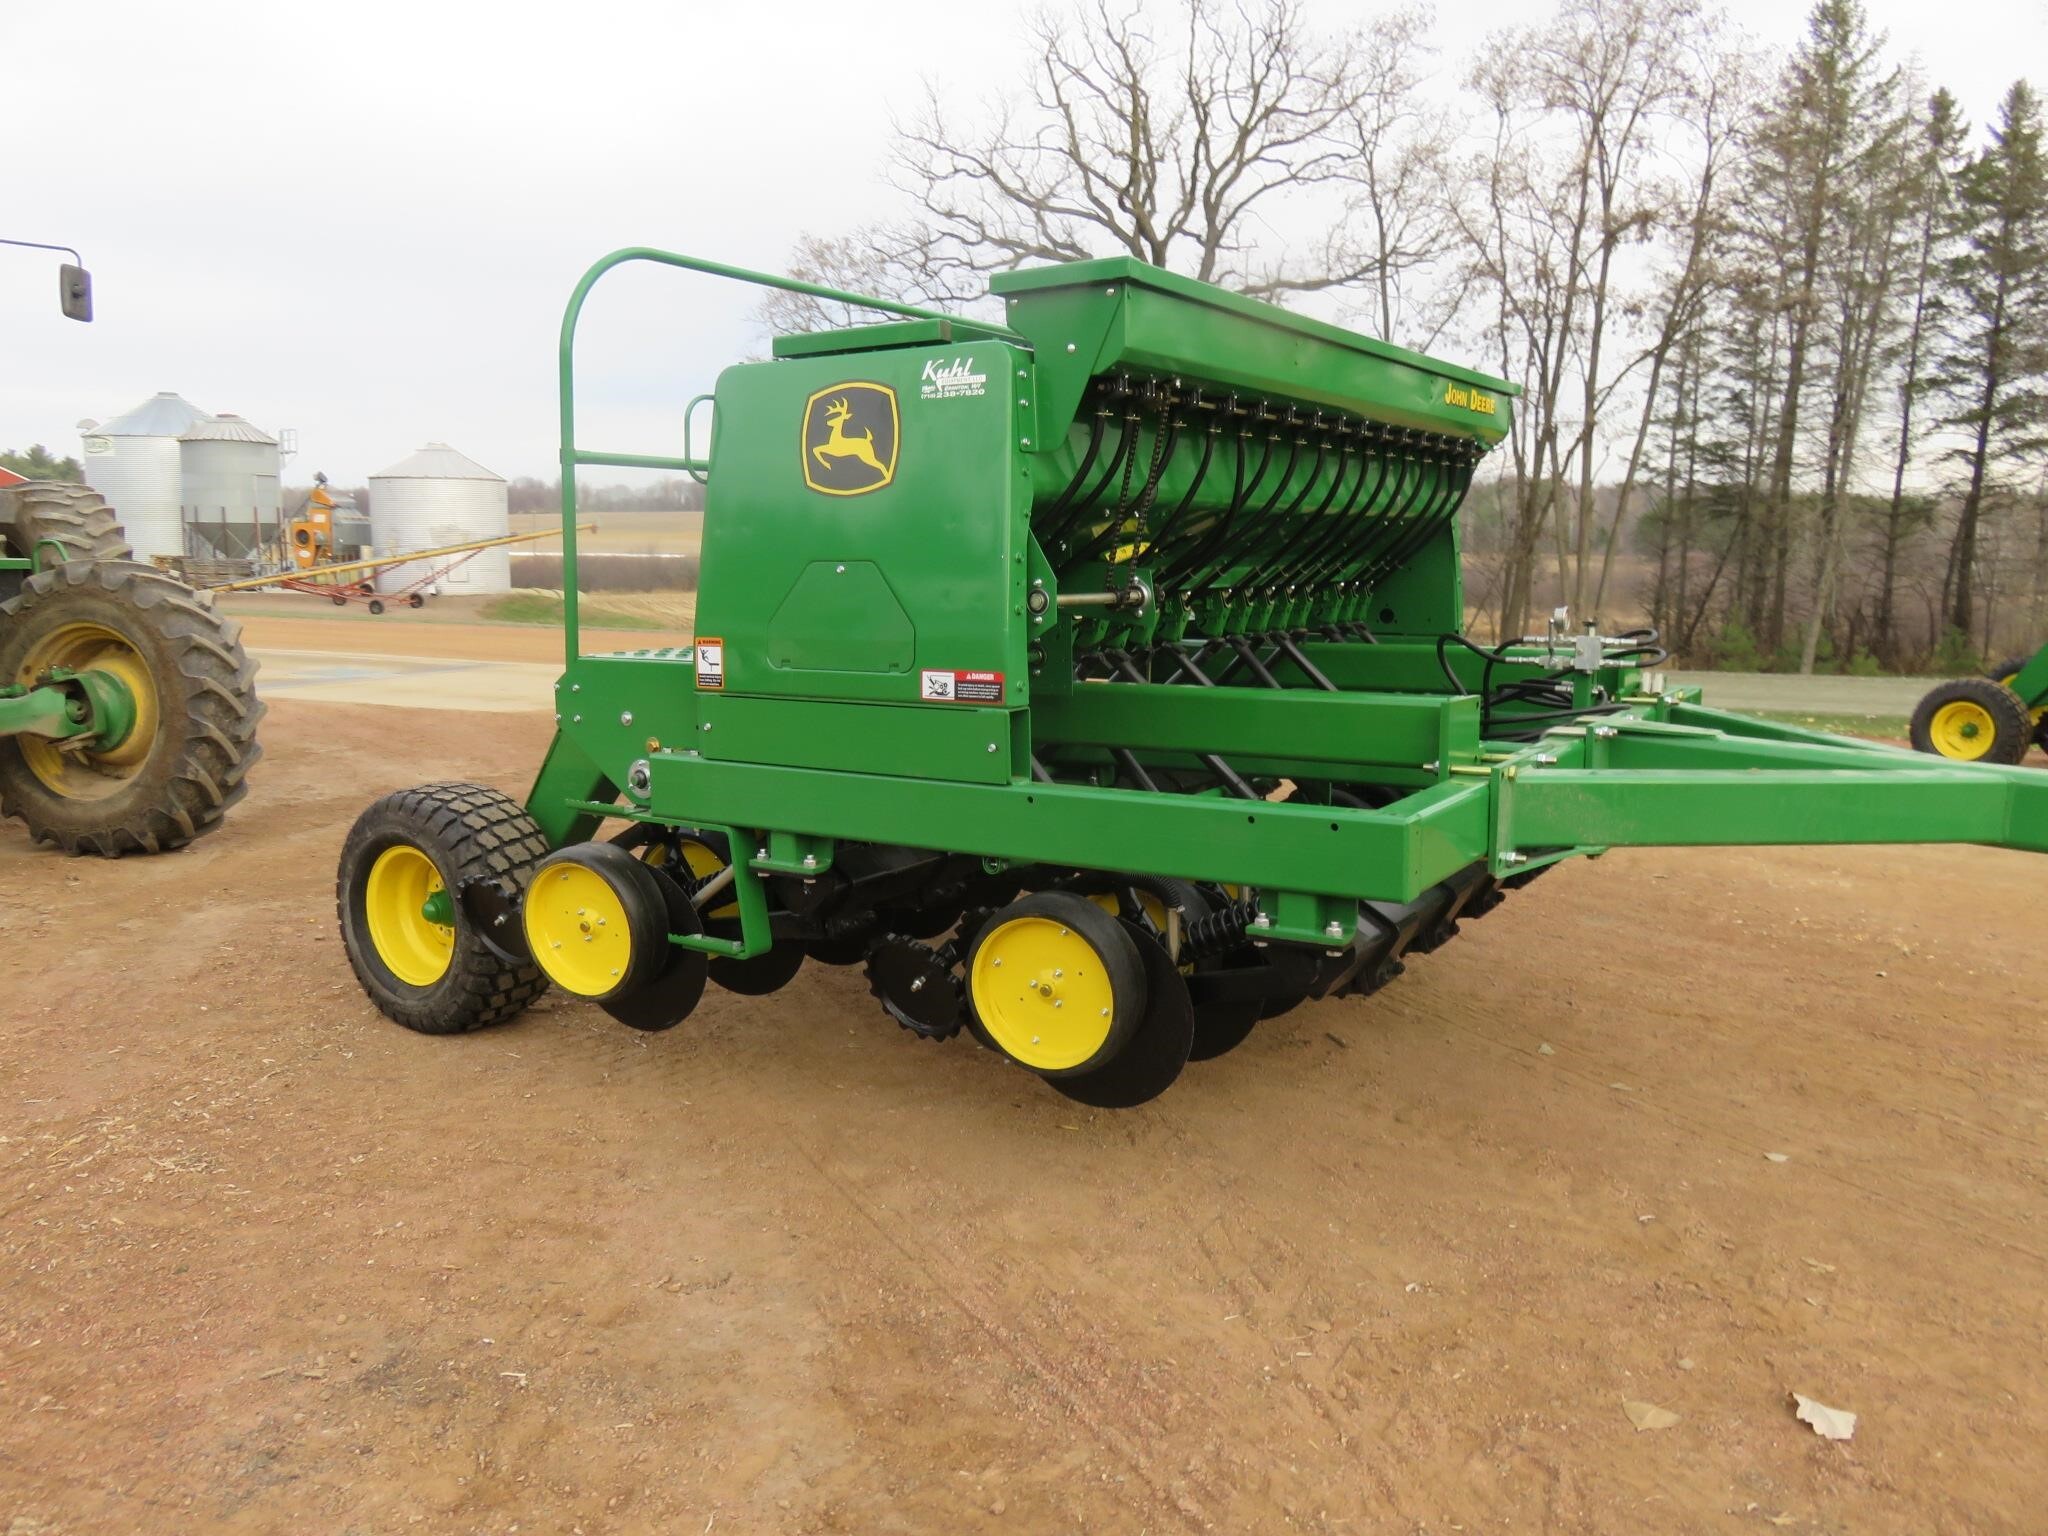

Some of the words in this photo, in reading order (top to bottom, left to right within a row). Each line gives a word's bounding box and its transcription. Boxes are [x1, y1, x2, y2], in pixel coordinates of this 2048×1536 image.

[921, 358, 971, 380] Kuhl
[1445, 383, 1467, 406] JOHN
[1471, 389, 1495, 414] DEERE
